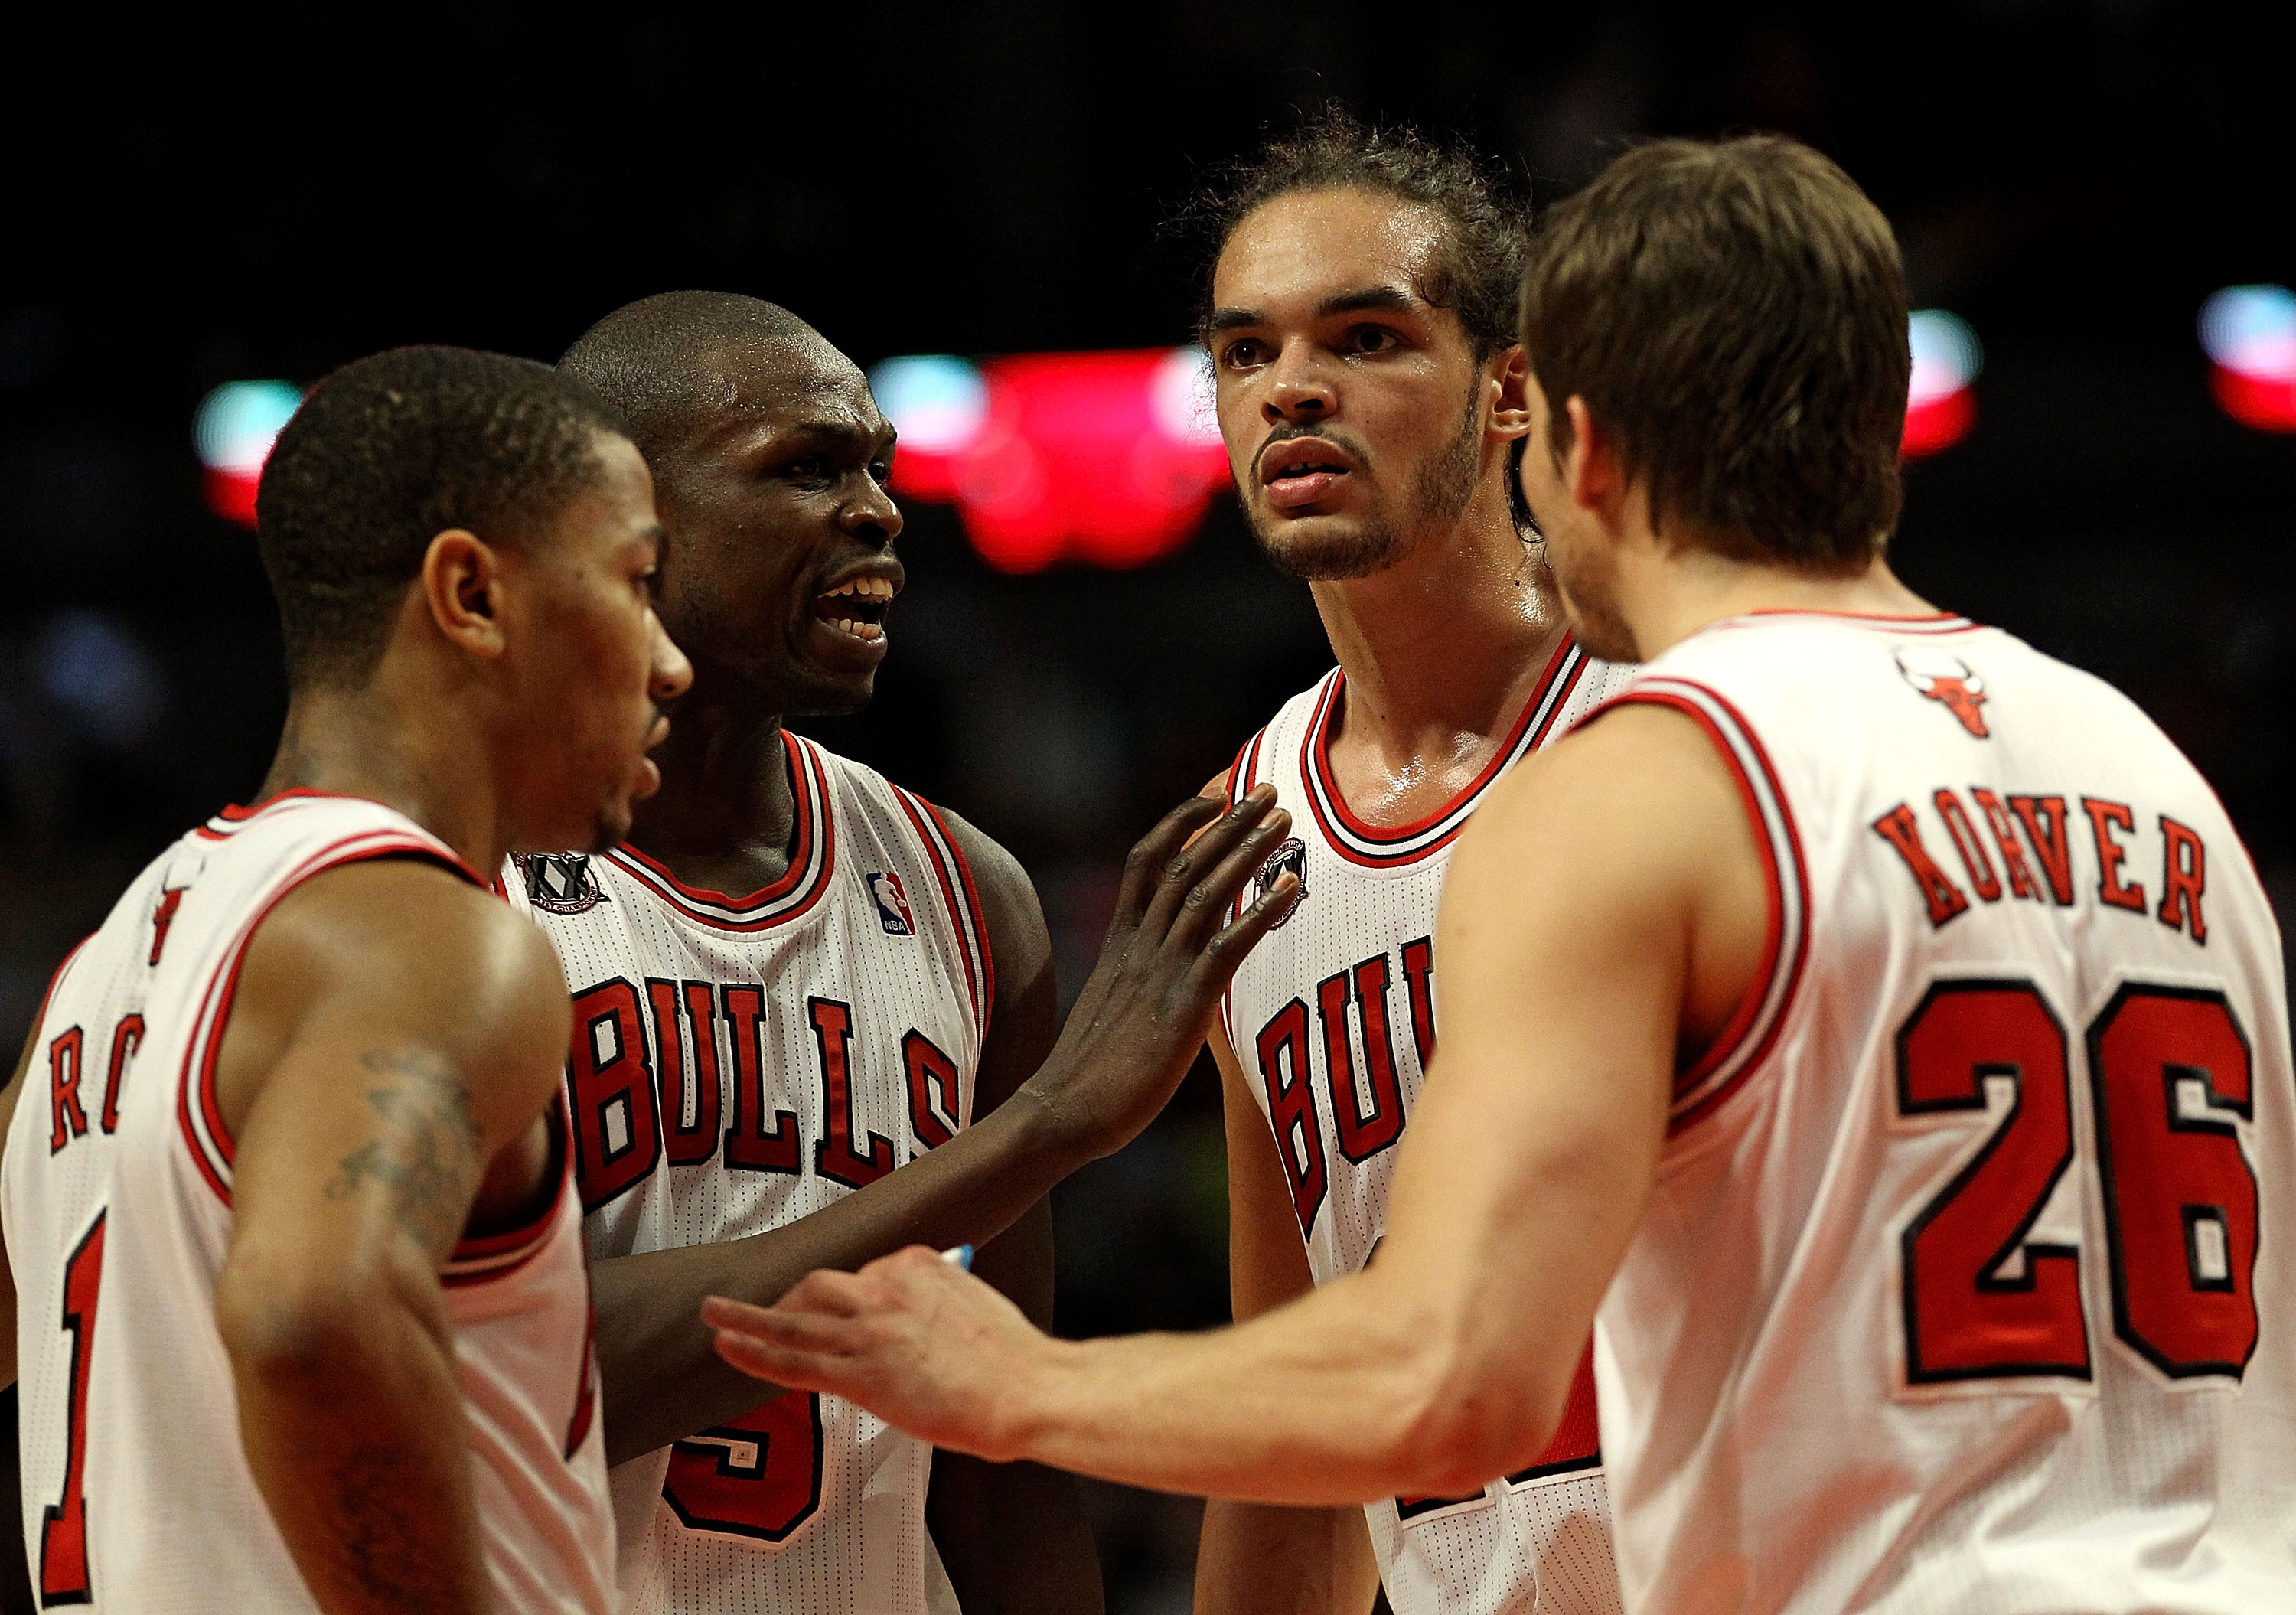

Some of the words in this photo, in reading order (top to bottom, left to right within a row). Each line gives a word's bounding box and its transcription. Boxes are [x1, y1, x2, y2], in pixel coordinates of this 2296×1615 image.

[884, 920, 906, 931] NBA
[1870, 786, 2207, 947] KORVER
[1895, 978, 2259, 1383] 26
[40, 1205, 109, 1610] 1
